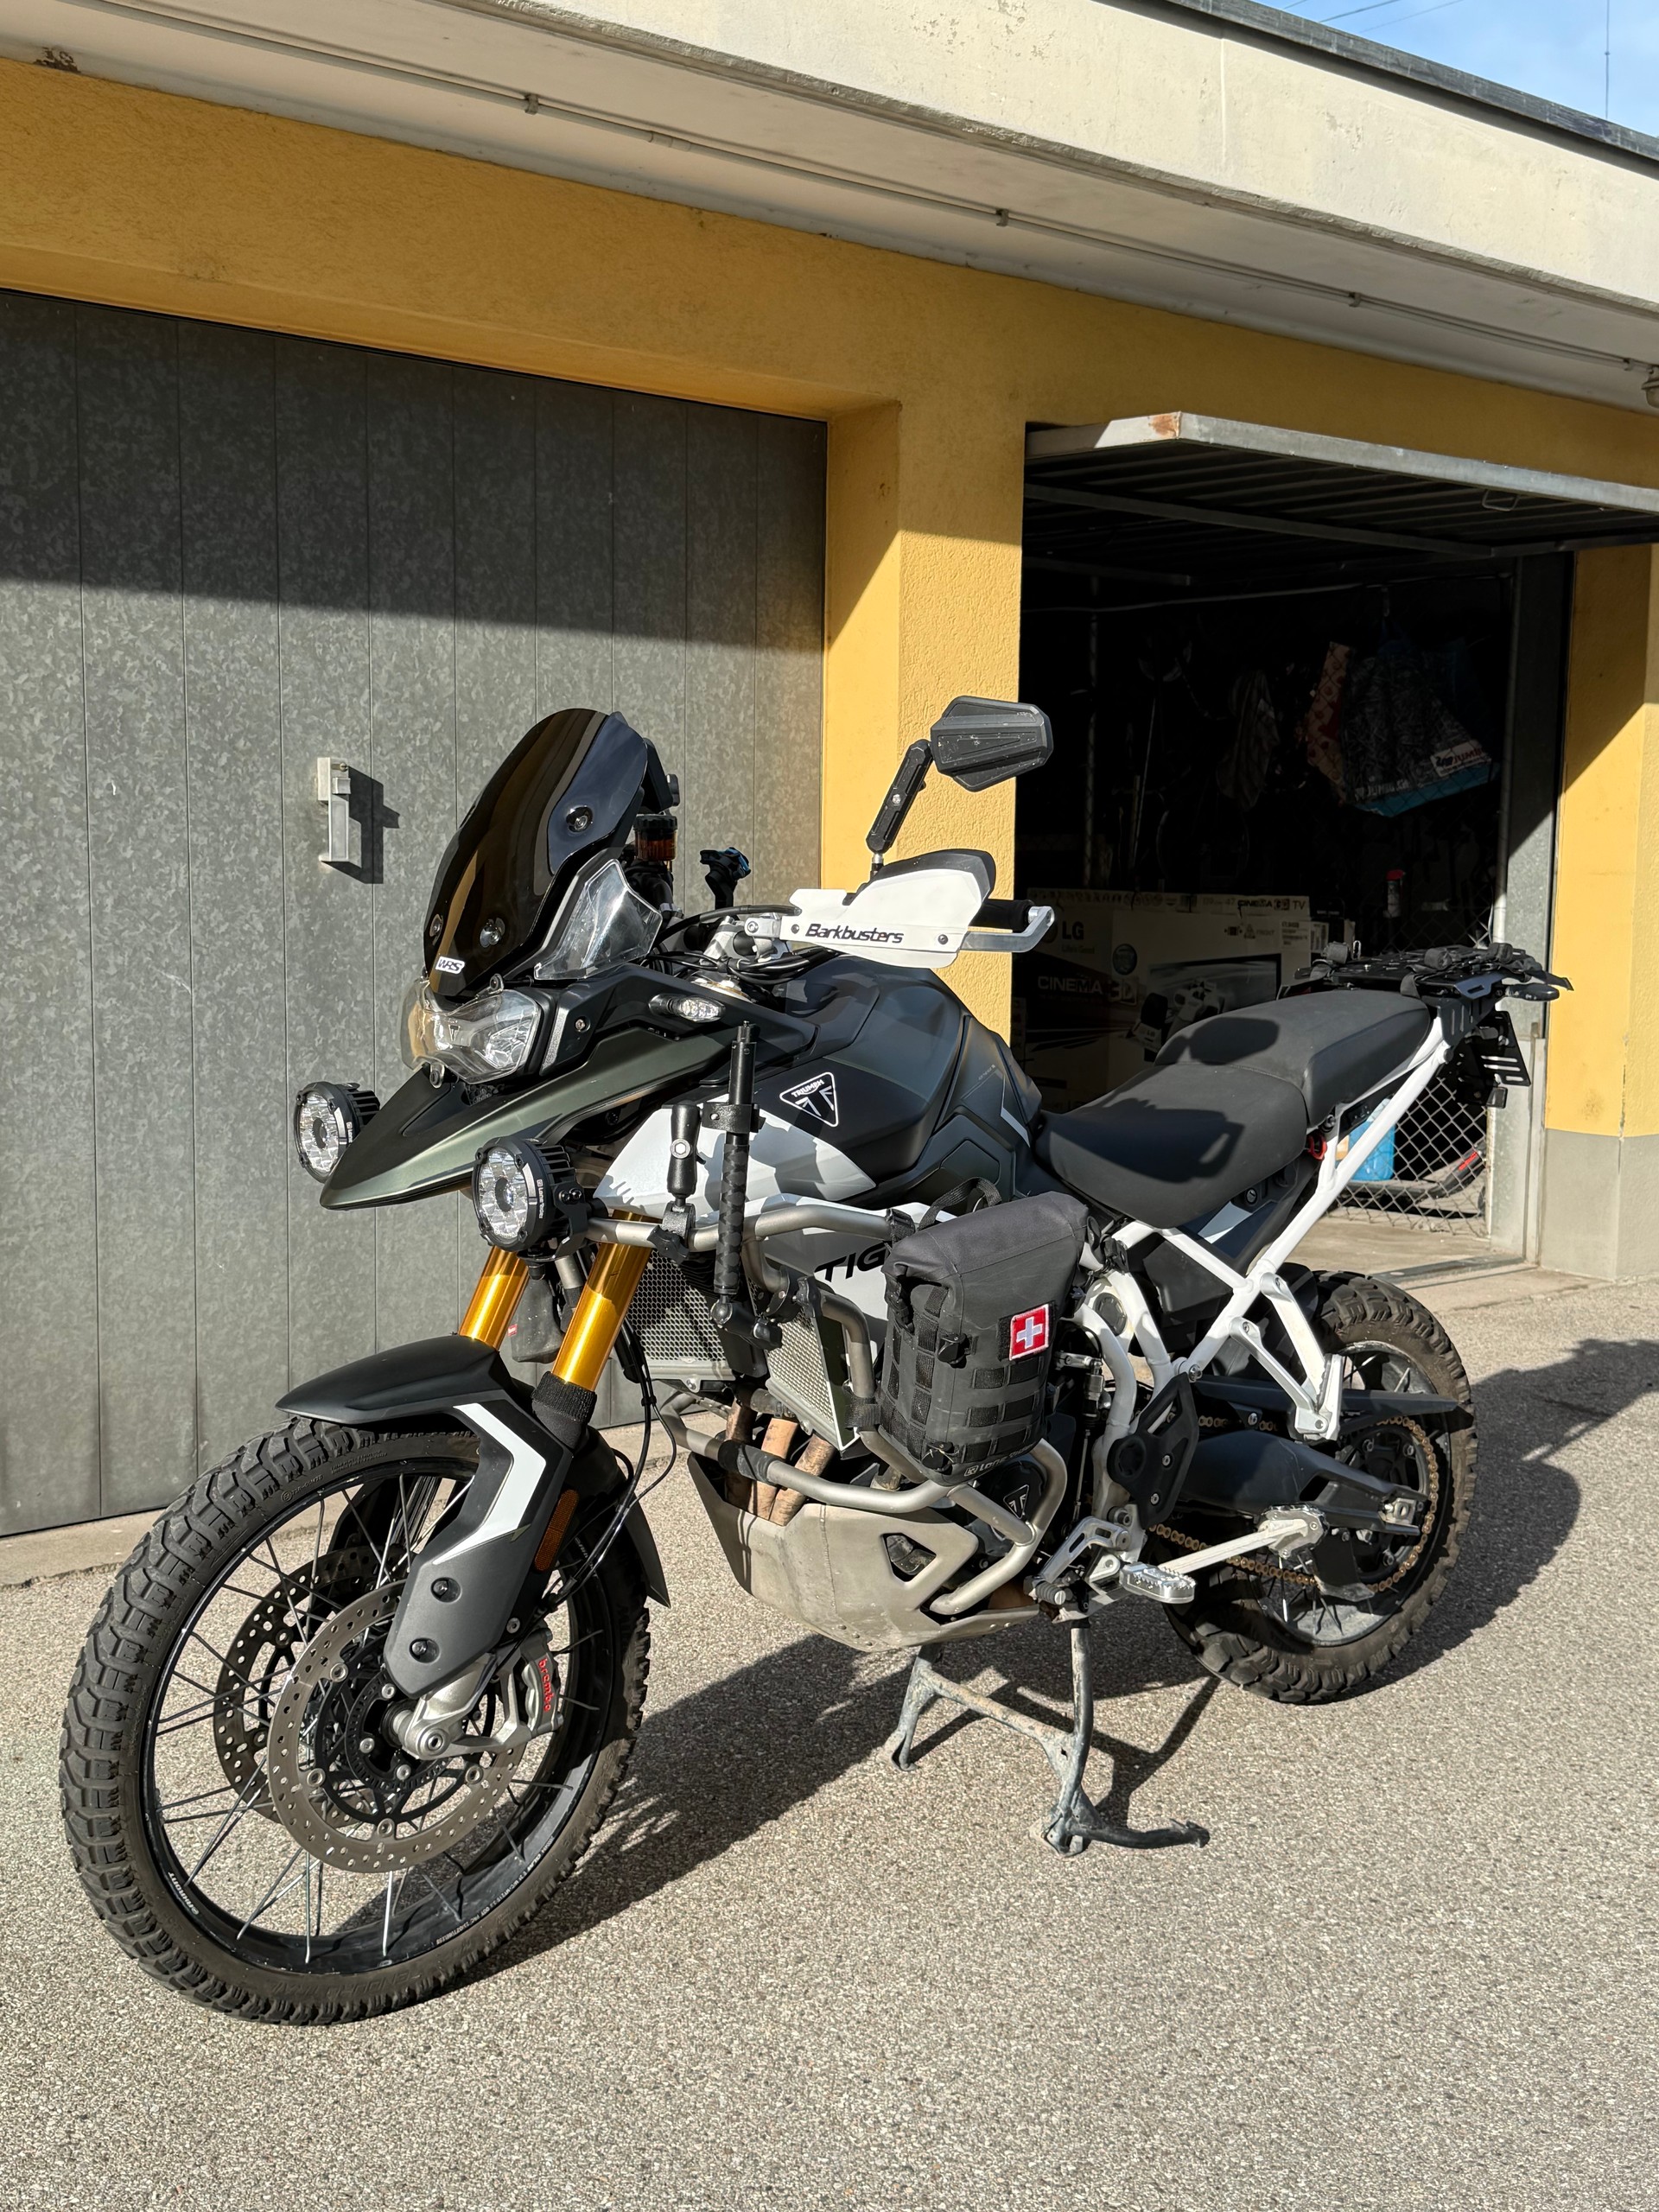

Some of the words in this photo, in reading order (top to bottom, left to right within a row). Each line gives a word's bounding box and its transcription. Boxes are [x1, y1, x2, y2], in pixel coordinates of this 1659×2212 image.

[1293, 900, 1306, 910] TV
[805, 923, 905, 944] Barkbusters
[1062, 921, 1084, 940] LG
[437, 958, 463, 972] WRS
[1037, 975, 1103, 995] CINEMA
[1107, 979, 1136, 1004] 3D
[791, 1078, 825, 1098] TRIUMPH
[814, 1241, 887, 1283] TIG
[538, 1657, 555, 1713] brembo
